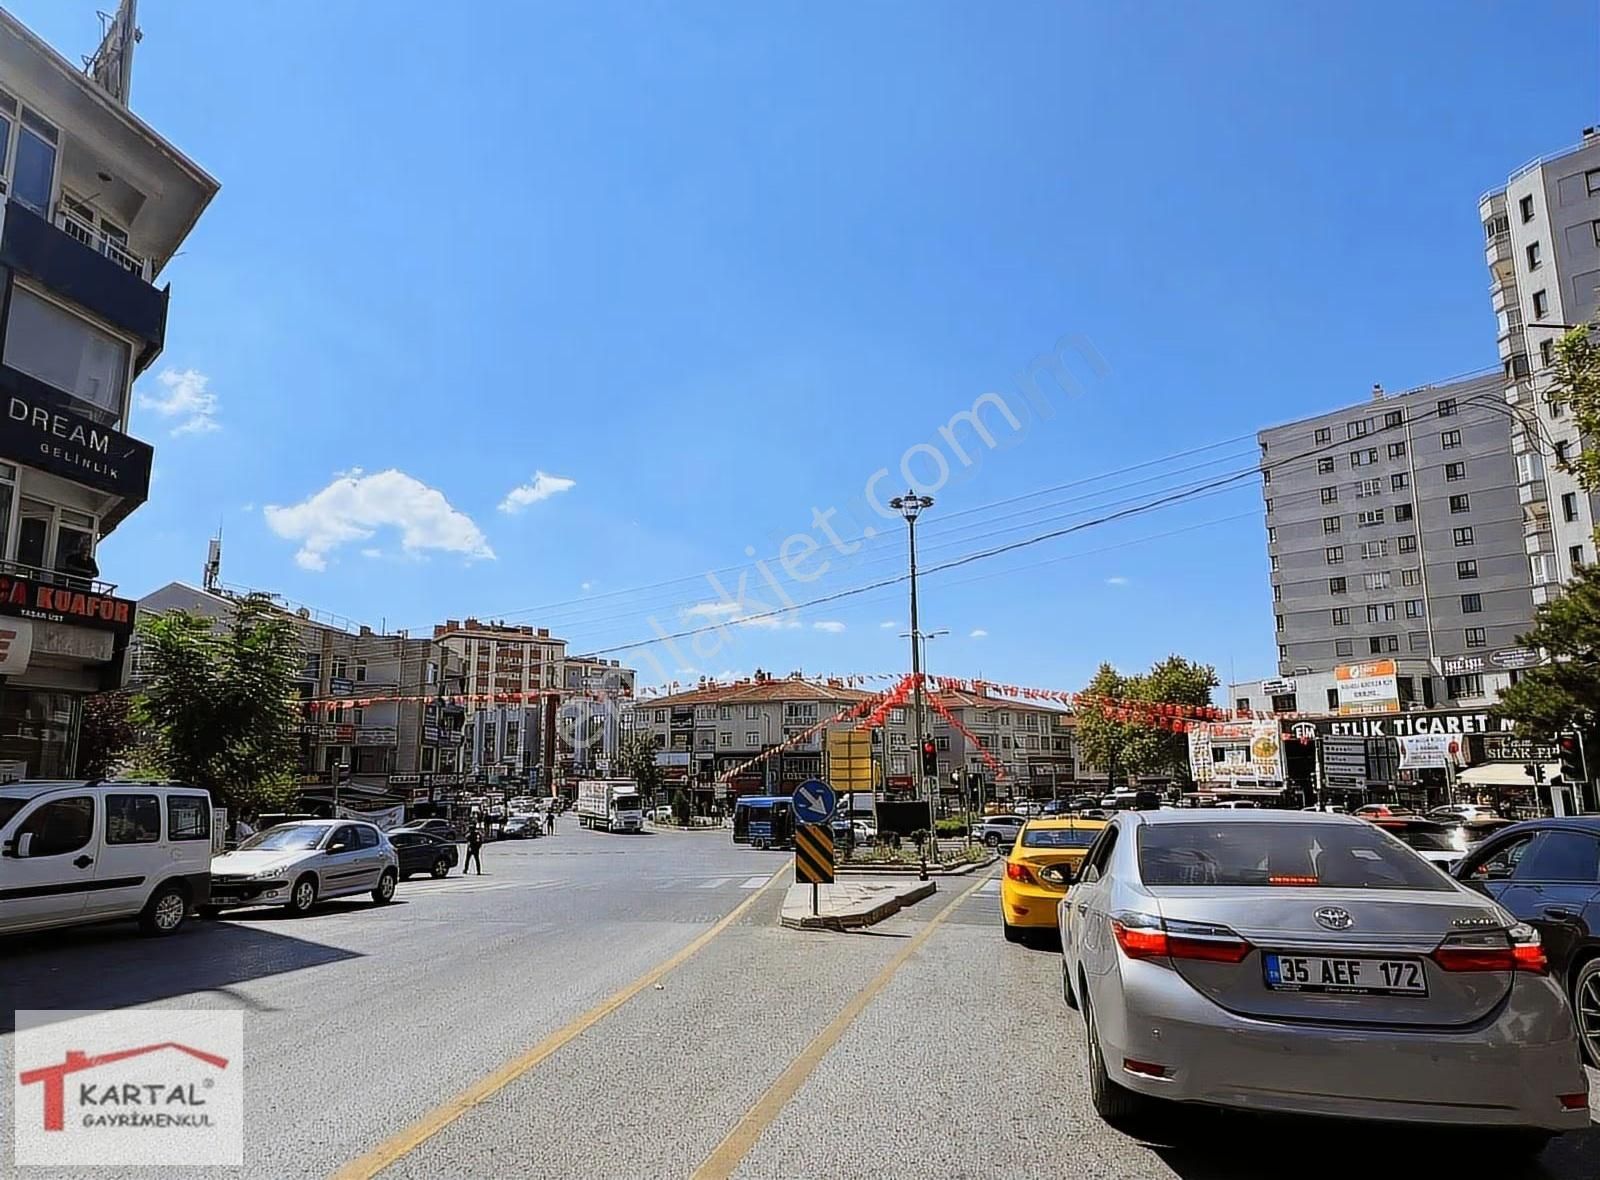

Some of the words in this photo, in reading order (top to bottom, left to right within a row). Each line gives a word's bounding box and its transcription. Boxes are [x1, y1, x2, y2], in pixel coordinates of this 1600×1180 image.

[9, 398, 109, 455] DREAM
[1331, 717, 1386, 737] ETLİK
[1393, 714, 1488, 736] TİCARET
[1281, 958, 1309, 983] 35
[1321, 959, 1361, 985] AEF
[1379, 961, 1421, 988] 172
